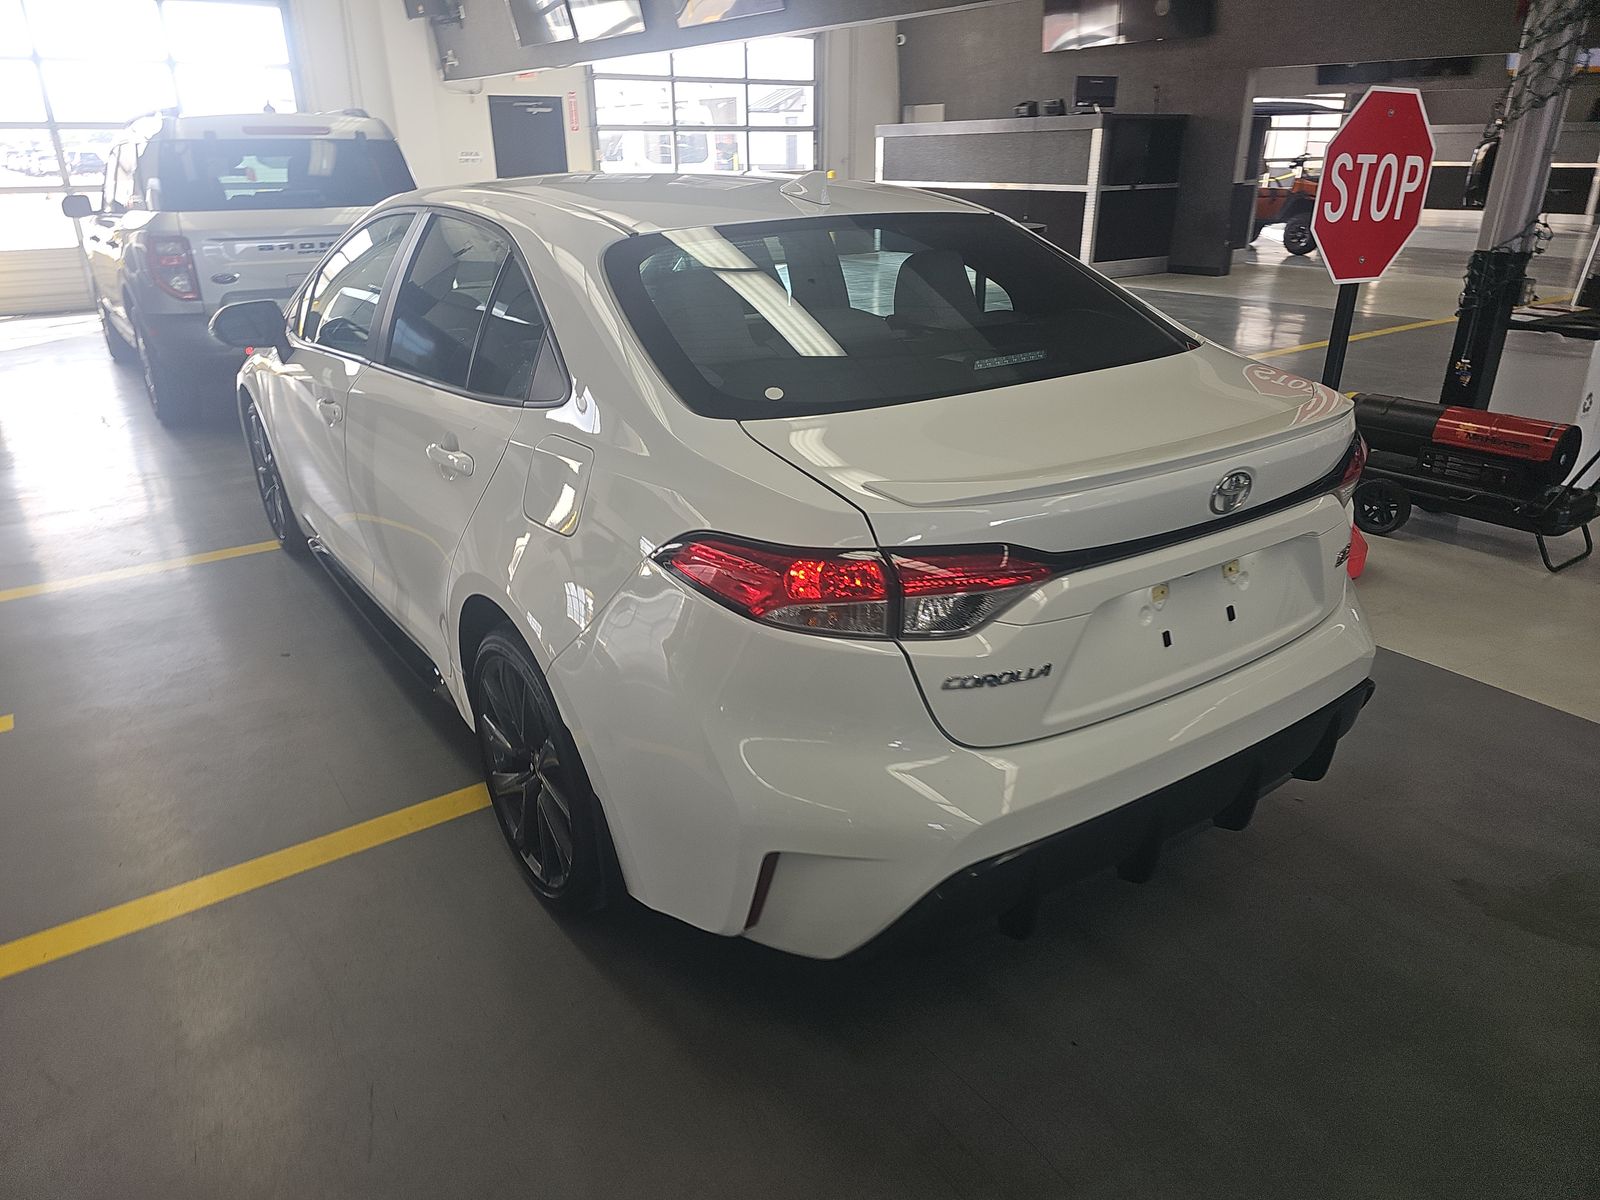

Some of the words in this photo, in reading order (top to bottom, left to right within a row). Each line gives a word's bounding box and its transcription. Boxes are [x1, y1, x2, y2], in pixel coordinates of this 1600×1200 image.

[1323, 152, 1424, 223] STOP
[257, 241, 336, 252] BRON
[941, 663, 1052, 690] COROLLA
